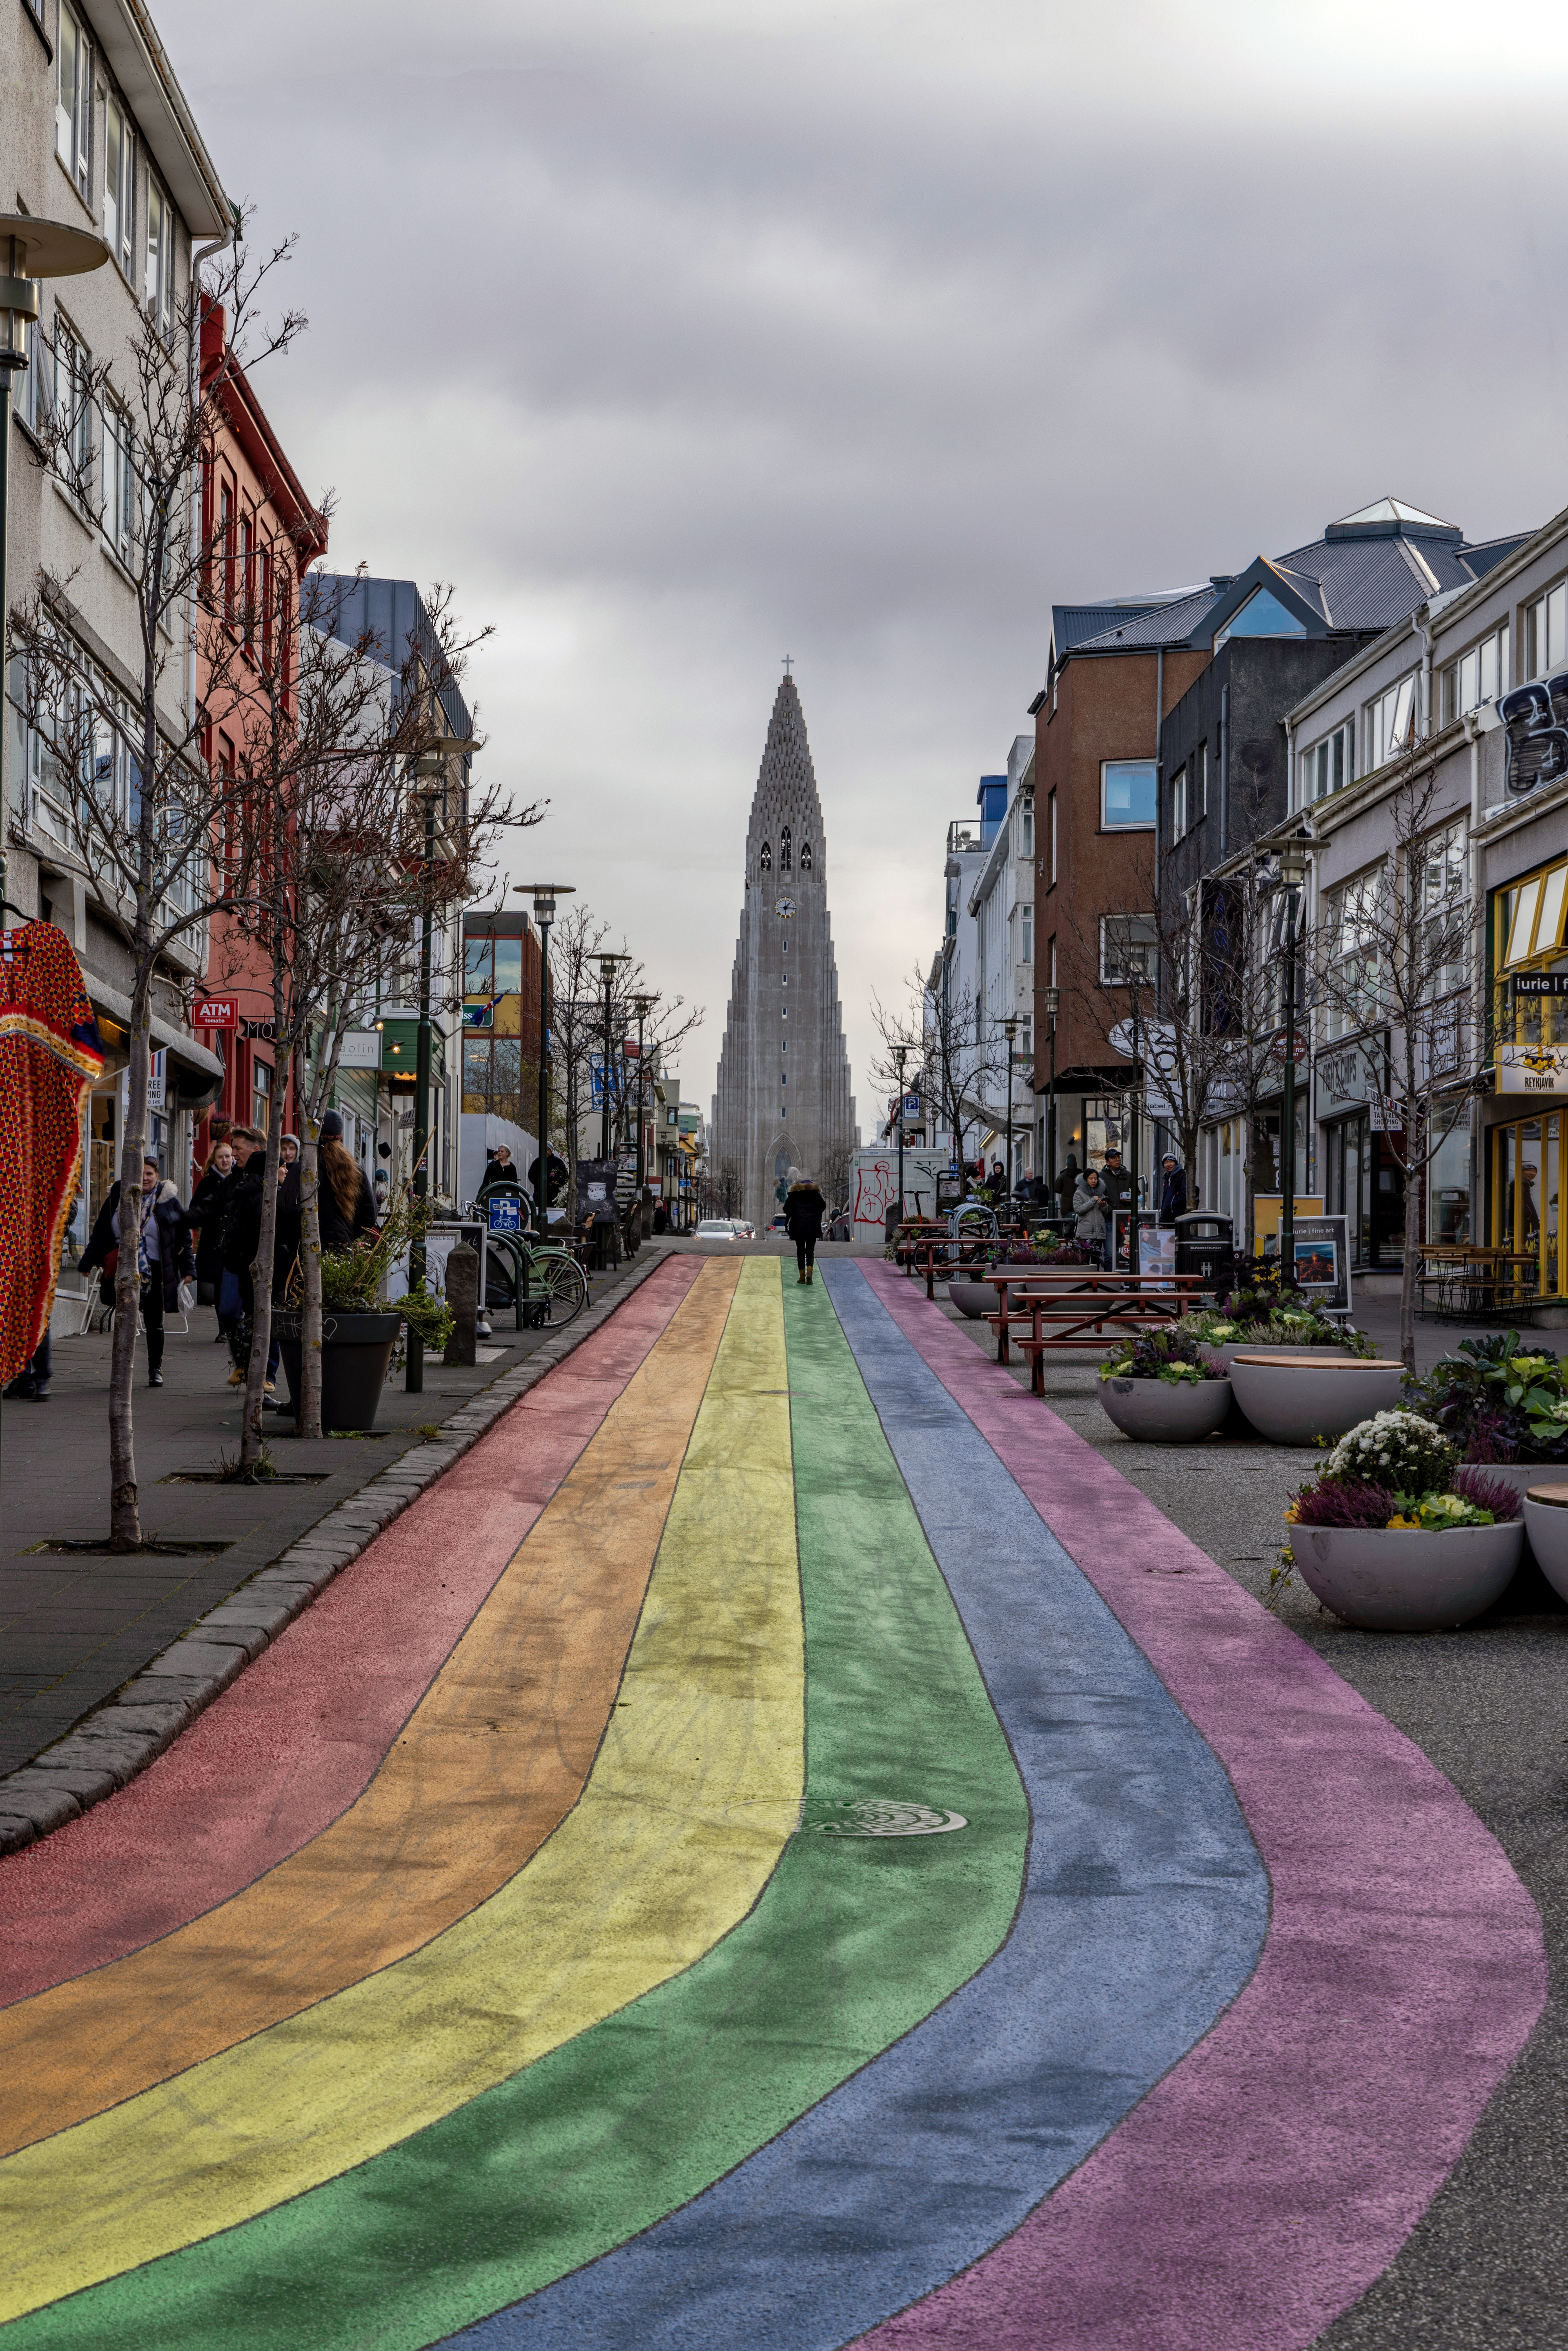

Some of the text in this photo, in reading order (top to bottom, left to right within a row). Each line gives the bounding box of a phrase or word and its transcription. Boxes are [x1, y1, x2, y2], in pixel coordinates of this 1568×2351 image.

[1517, 977, 1550, 990] iurie
[199, 1004, 231, 1016] ATM
[340, 1043, 374, 1053] aolin
[1341, 1052, 1356, 1086] CHIPS
[148, 1080, 161, 1089] REE
[1525, 1075, 1555, 1090] REYKJAVÍK
[500, 1200, 510, 1215] P
